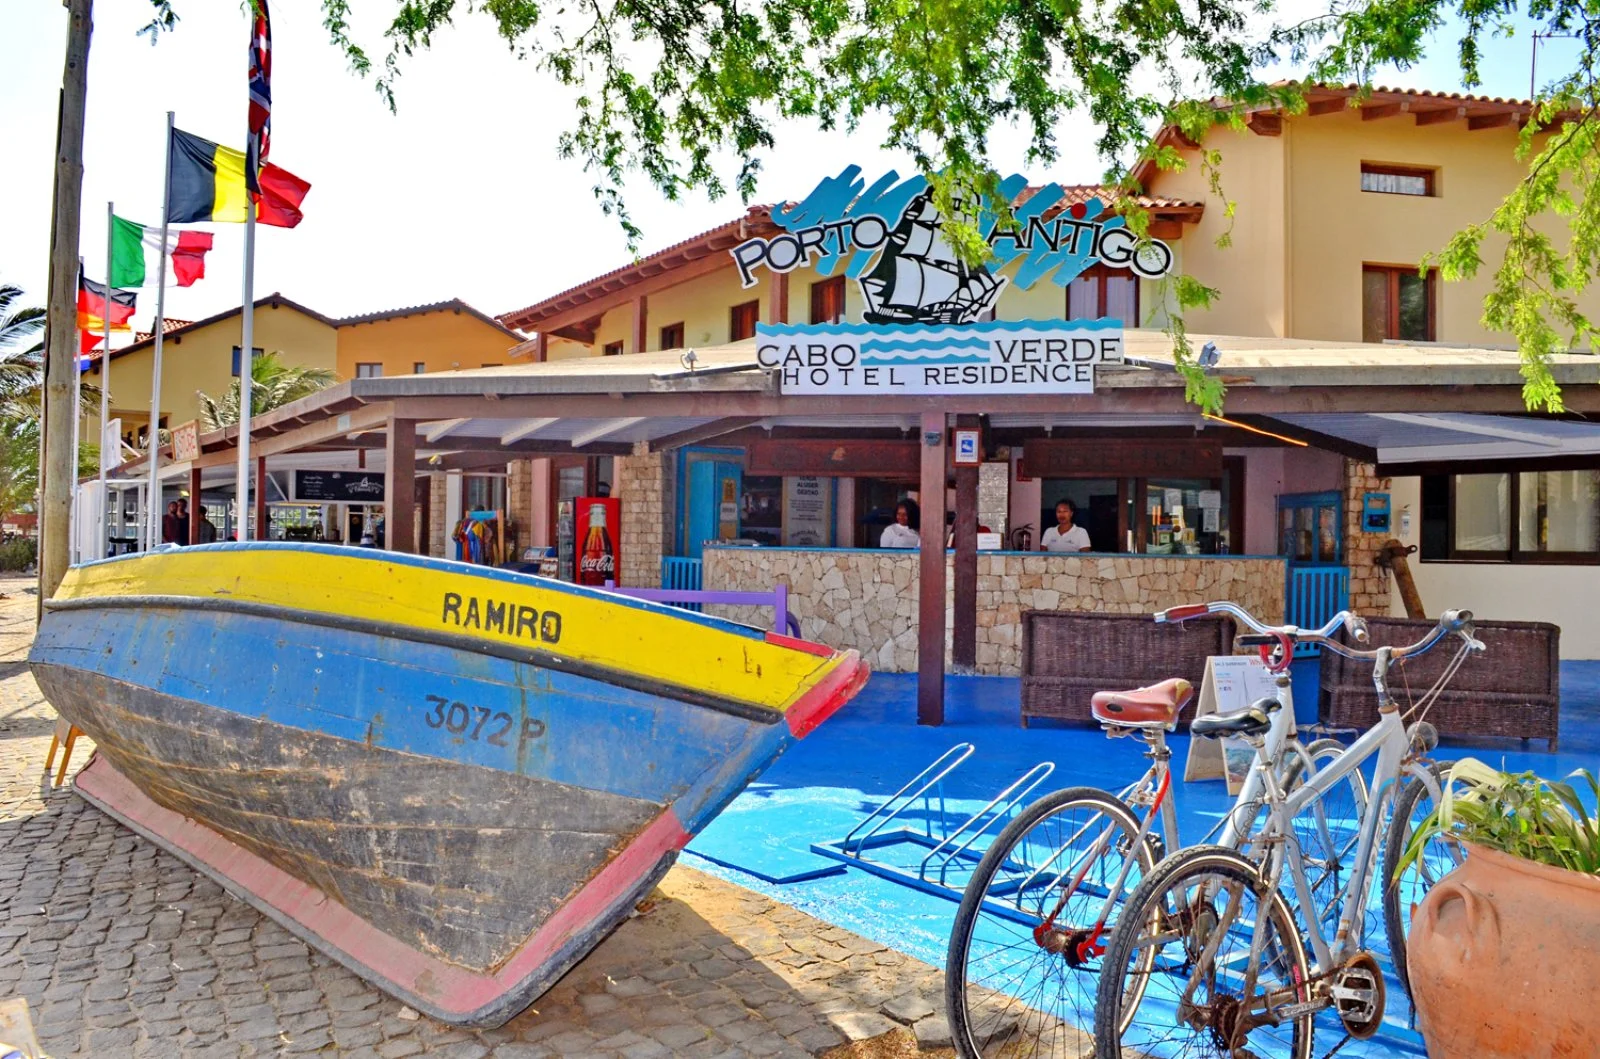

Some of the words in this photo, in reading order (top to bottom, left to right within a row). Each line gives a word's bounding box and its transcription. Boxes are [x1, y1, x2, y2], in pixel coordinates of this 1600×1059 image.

[733, 215, 888, 286] PORTO
[985, 206, 1171, 276] ANTIGO
[757, 344, 856, 367] CABO
[995, 337, 1121, 363] VERDE
[783, 367, 905, 386] HOTEL
[924, 363, 1091, 386] RESIDENCE
[442, 592, 562, 644] RAMIRO
[425, 695, 513, 748] 3072
[518, 715, 546, 756] P
